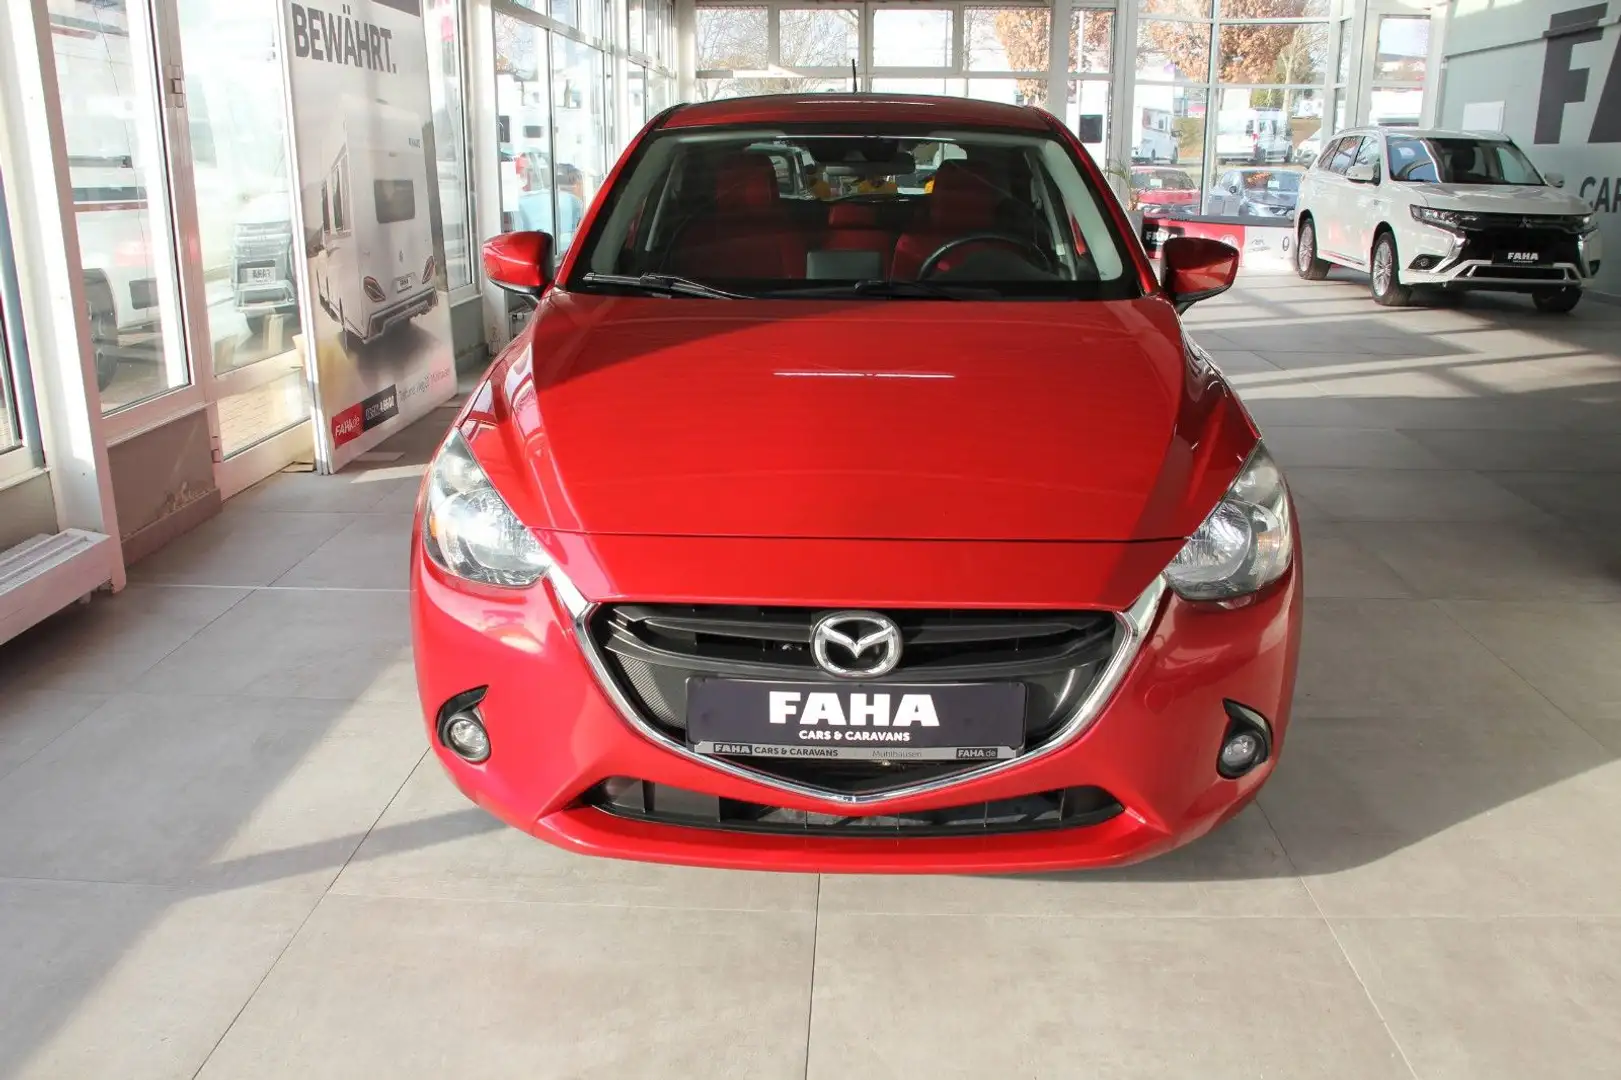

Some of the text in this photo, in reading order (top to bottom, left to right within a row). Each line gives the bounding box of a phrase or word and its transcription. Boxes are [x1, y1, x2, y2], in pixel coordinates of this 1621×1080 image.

[292, 2, 397, 74] BEWÄHRT.
[1507, 252, 1539, 260] FAHA
[769, 691, 940, 727] FAHA
[799, 730, 910, 742] CARS & CARAVANS
[714, 744, 839, 757] FAHA CARS & CARAVANS
